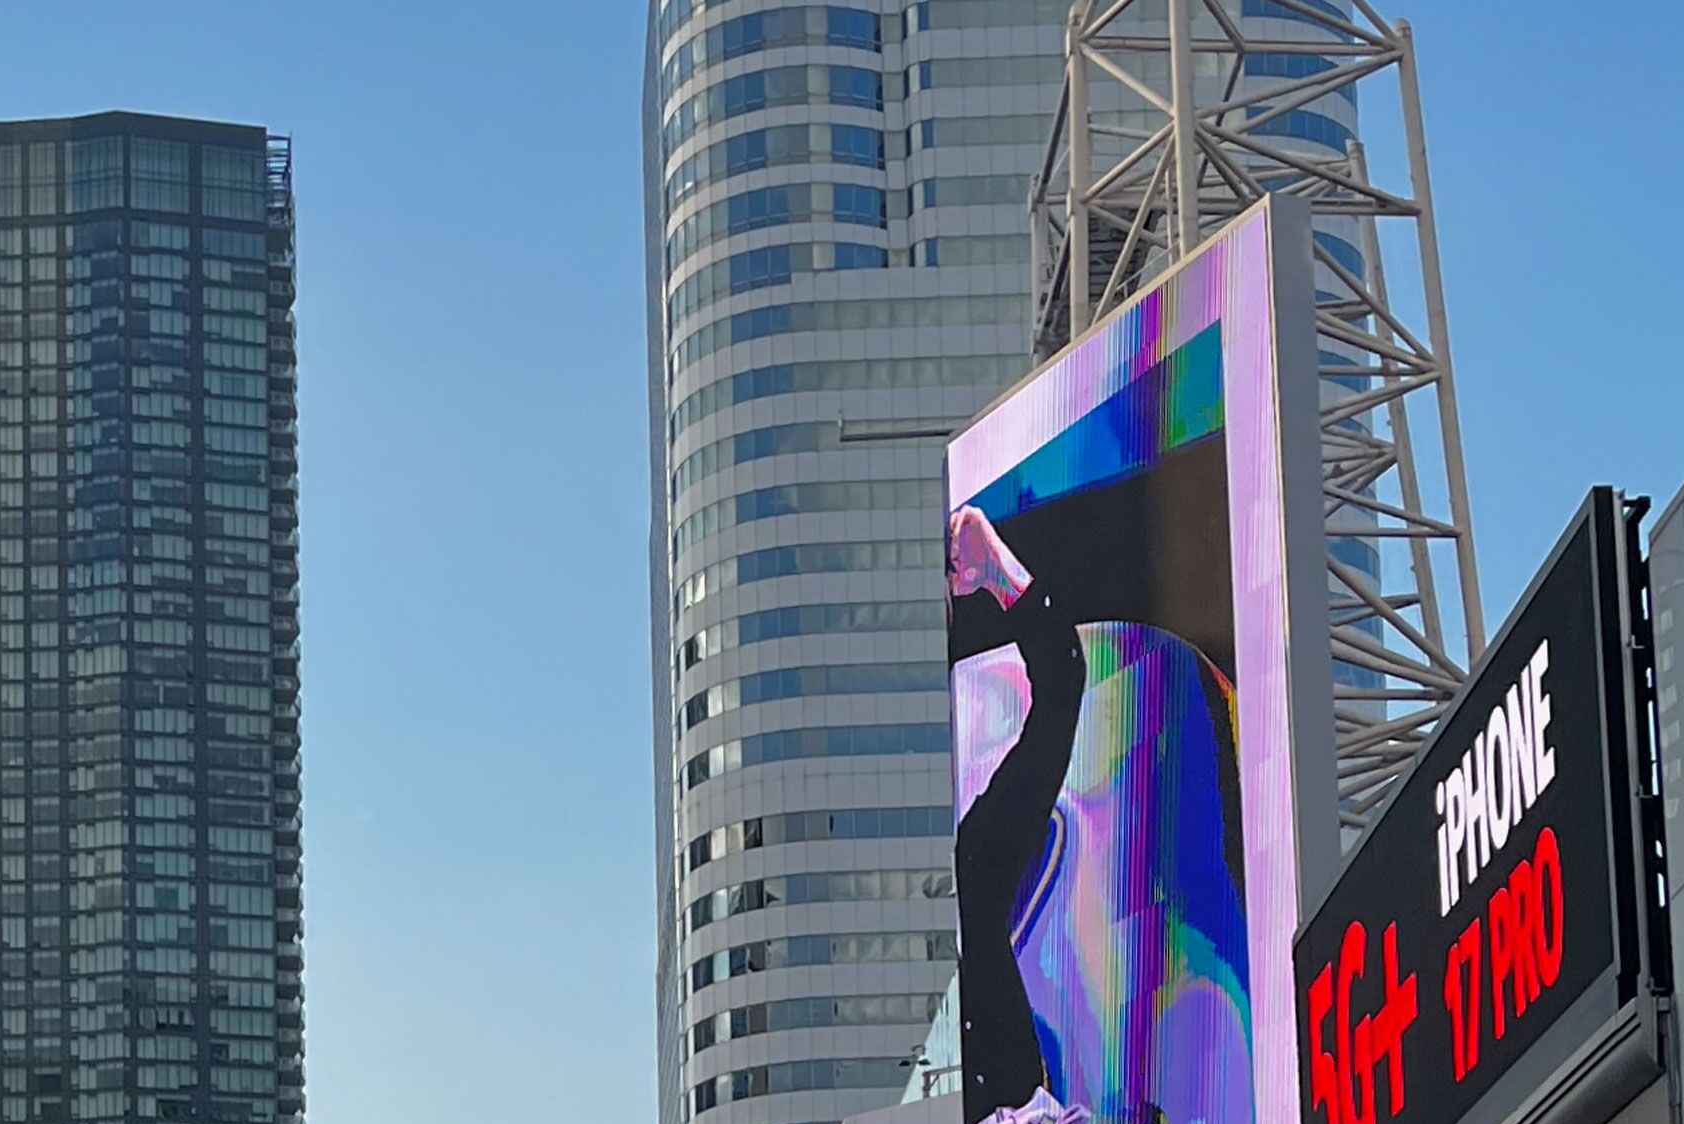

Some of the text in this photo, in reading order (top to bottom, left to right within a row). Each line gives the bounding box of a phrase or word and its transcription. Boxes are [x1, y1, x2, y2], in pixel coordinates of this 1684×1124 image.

[1435, 638, 1556, 918] iPHONE
[1443, 826, 1565, 1083] 17 PRO
